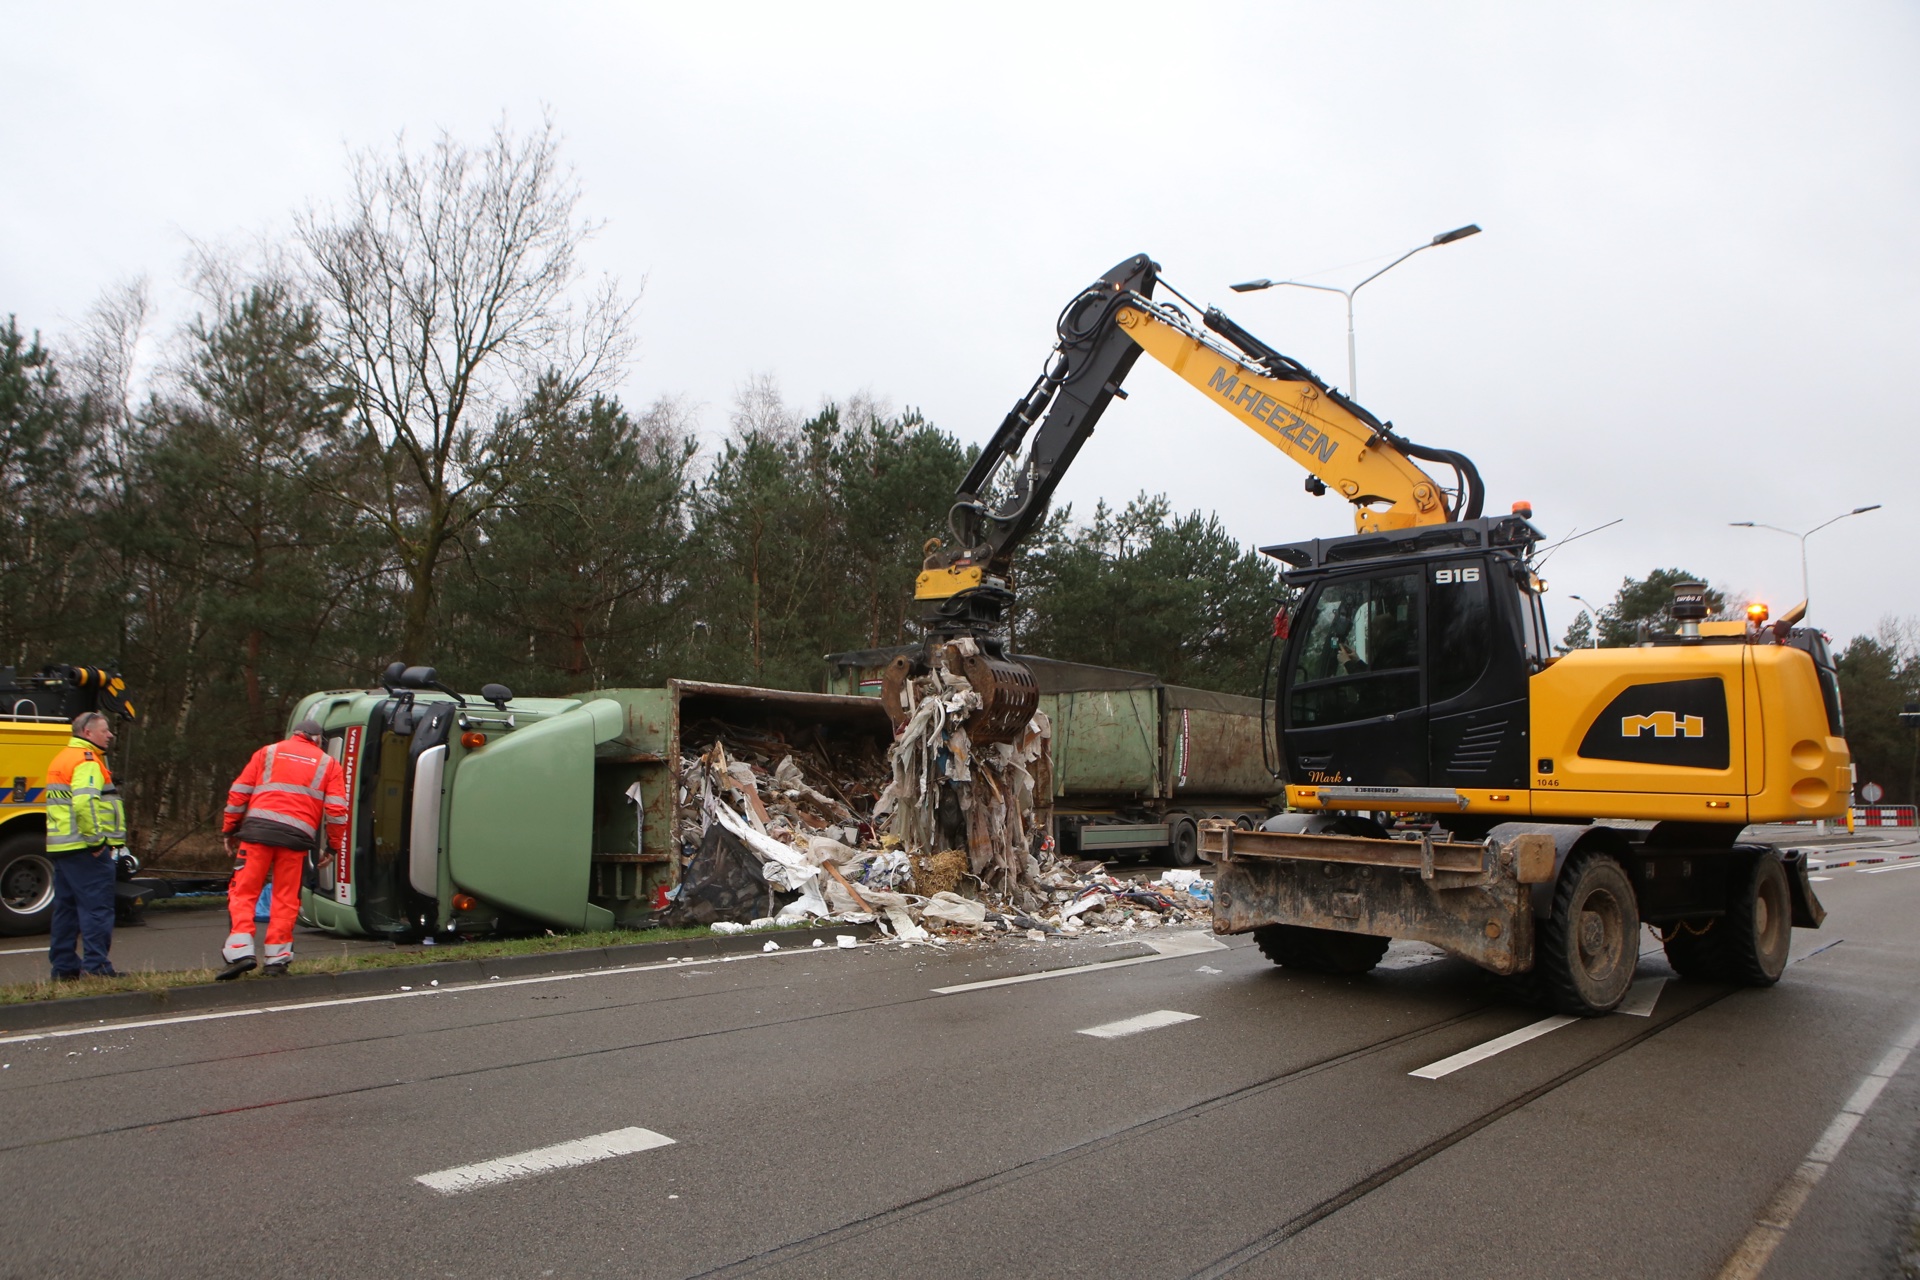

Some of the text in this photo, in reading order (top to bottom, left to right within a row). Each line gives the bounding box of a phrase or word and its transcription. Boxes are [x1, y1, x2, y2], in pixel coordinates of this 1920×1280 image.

[1207, 366, 1339, 464] M.HEEZEN
[1435, 567, 1480, 584] 916
[1676, 594, 1696, 602] turbo
[1621, 710, 1704, 738] MH
[348, 728, 357, 753] van
[1308, 770, 1343, 783] Mark
[1537, 779, 1559, 787] 1046
